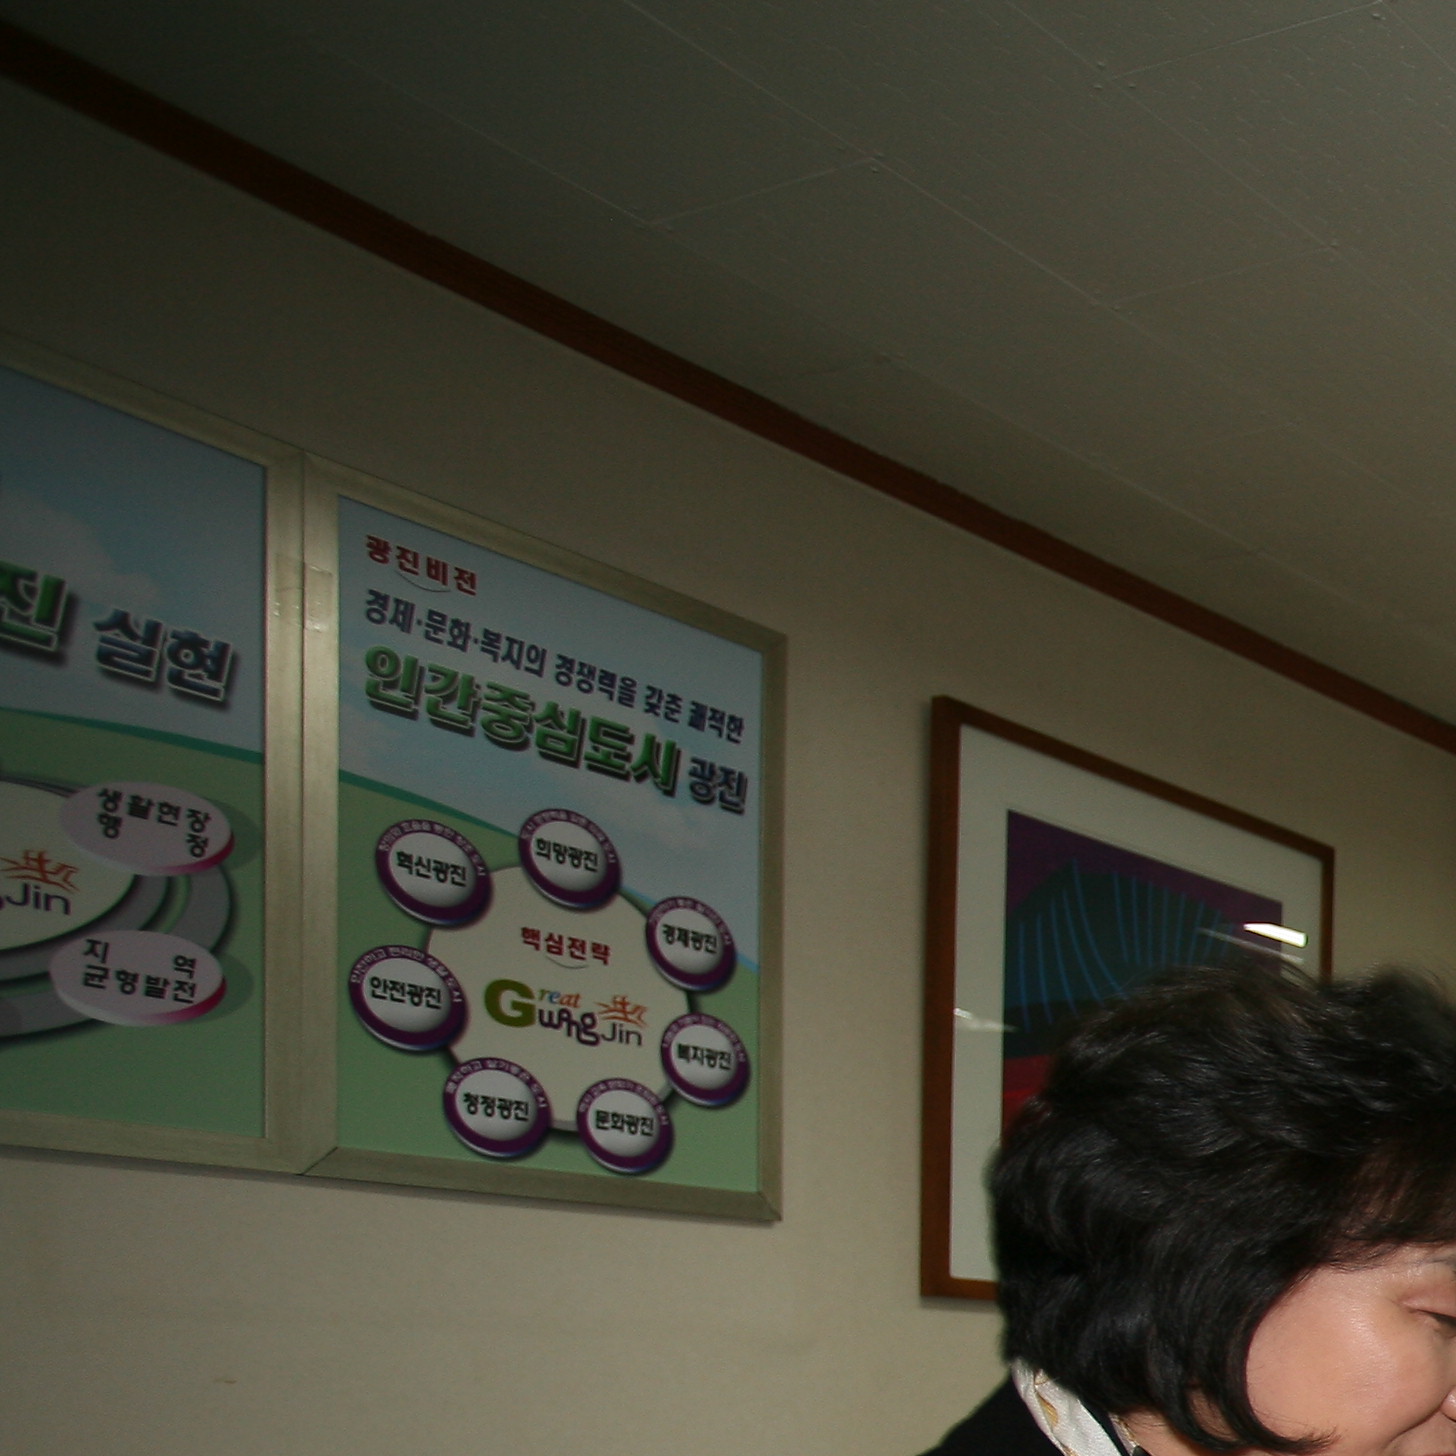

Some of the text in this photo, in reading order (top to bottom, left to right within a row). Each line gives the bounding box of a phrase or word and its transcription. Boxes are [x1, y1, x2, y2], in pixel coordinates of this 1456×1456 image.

[366, 535, 476, 595] 광진비전
[93, 607, 233, 703] 실현
[555, 654, 636, 708] 경쟁력을
[644, 685, 682, 723] 갖춘
[365, 646, 748, 815] 인간중심도시 광진
[397, 850, 467, 887] 혁신광진
[536, 837, 598, 872] 희망광진
[521, 927, 610, 965] 핵심전략
[662, 923, 718, 954] 경제광진
[370, 975, 442, 1009] 안전광진
[677, 1044, 732, 1071] 복지광진
[463, 1091, 530, 1121] 청정광진
[595, 1110, 654, 1137] 문화광진
